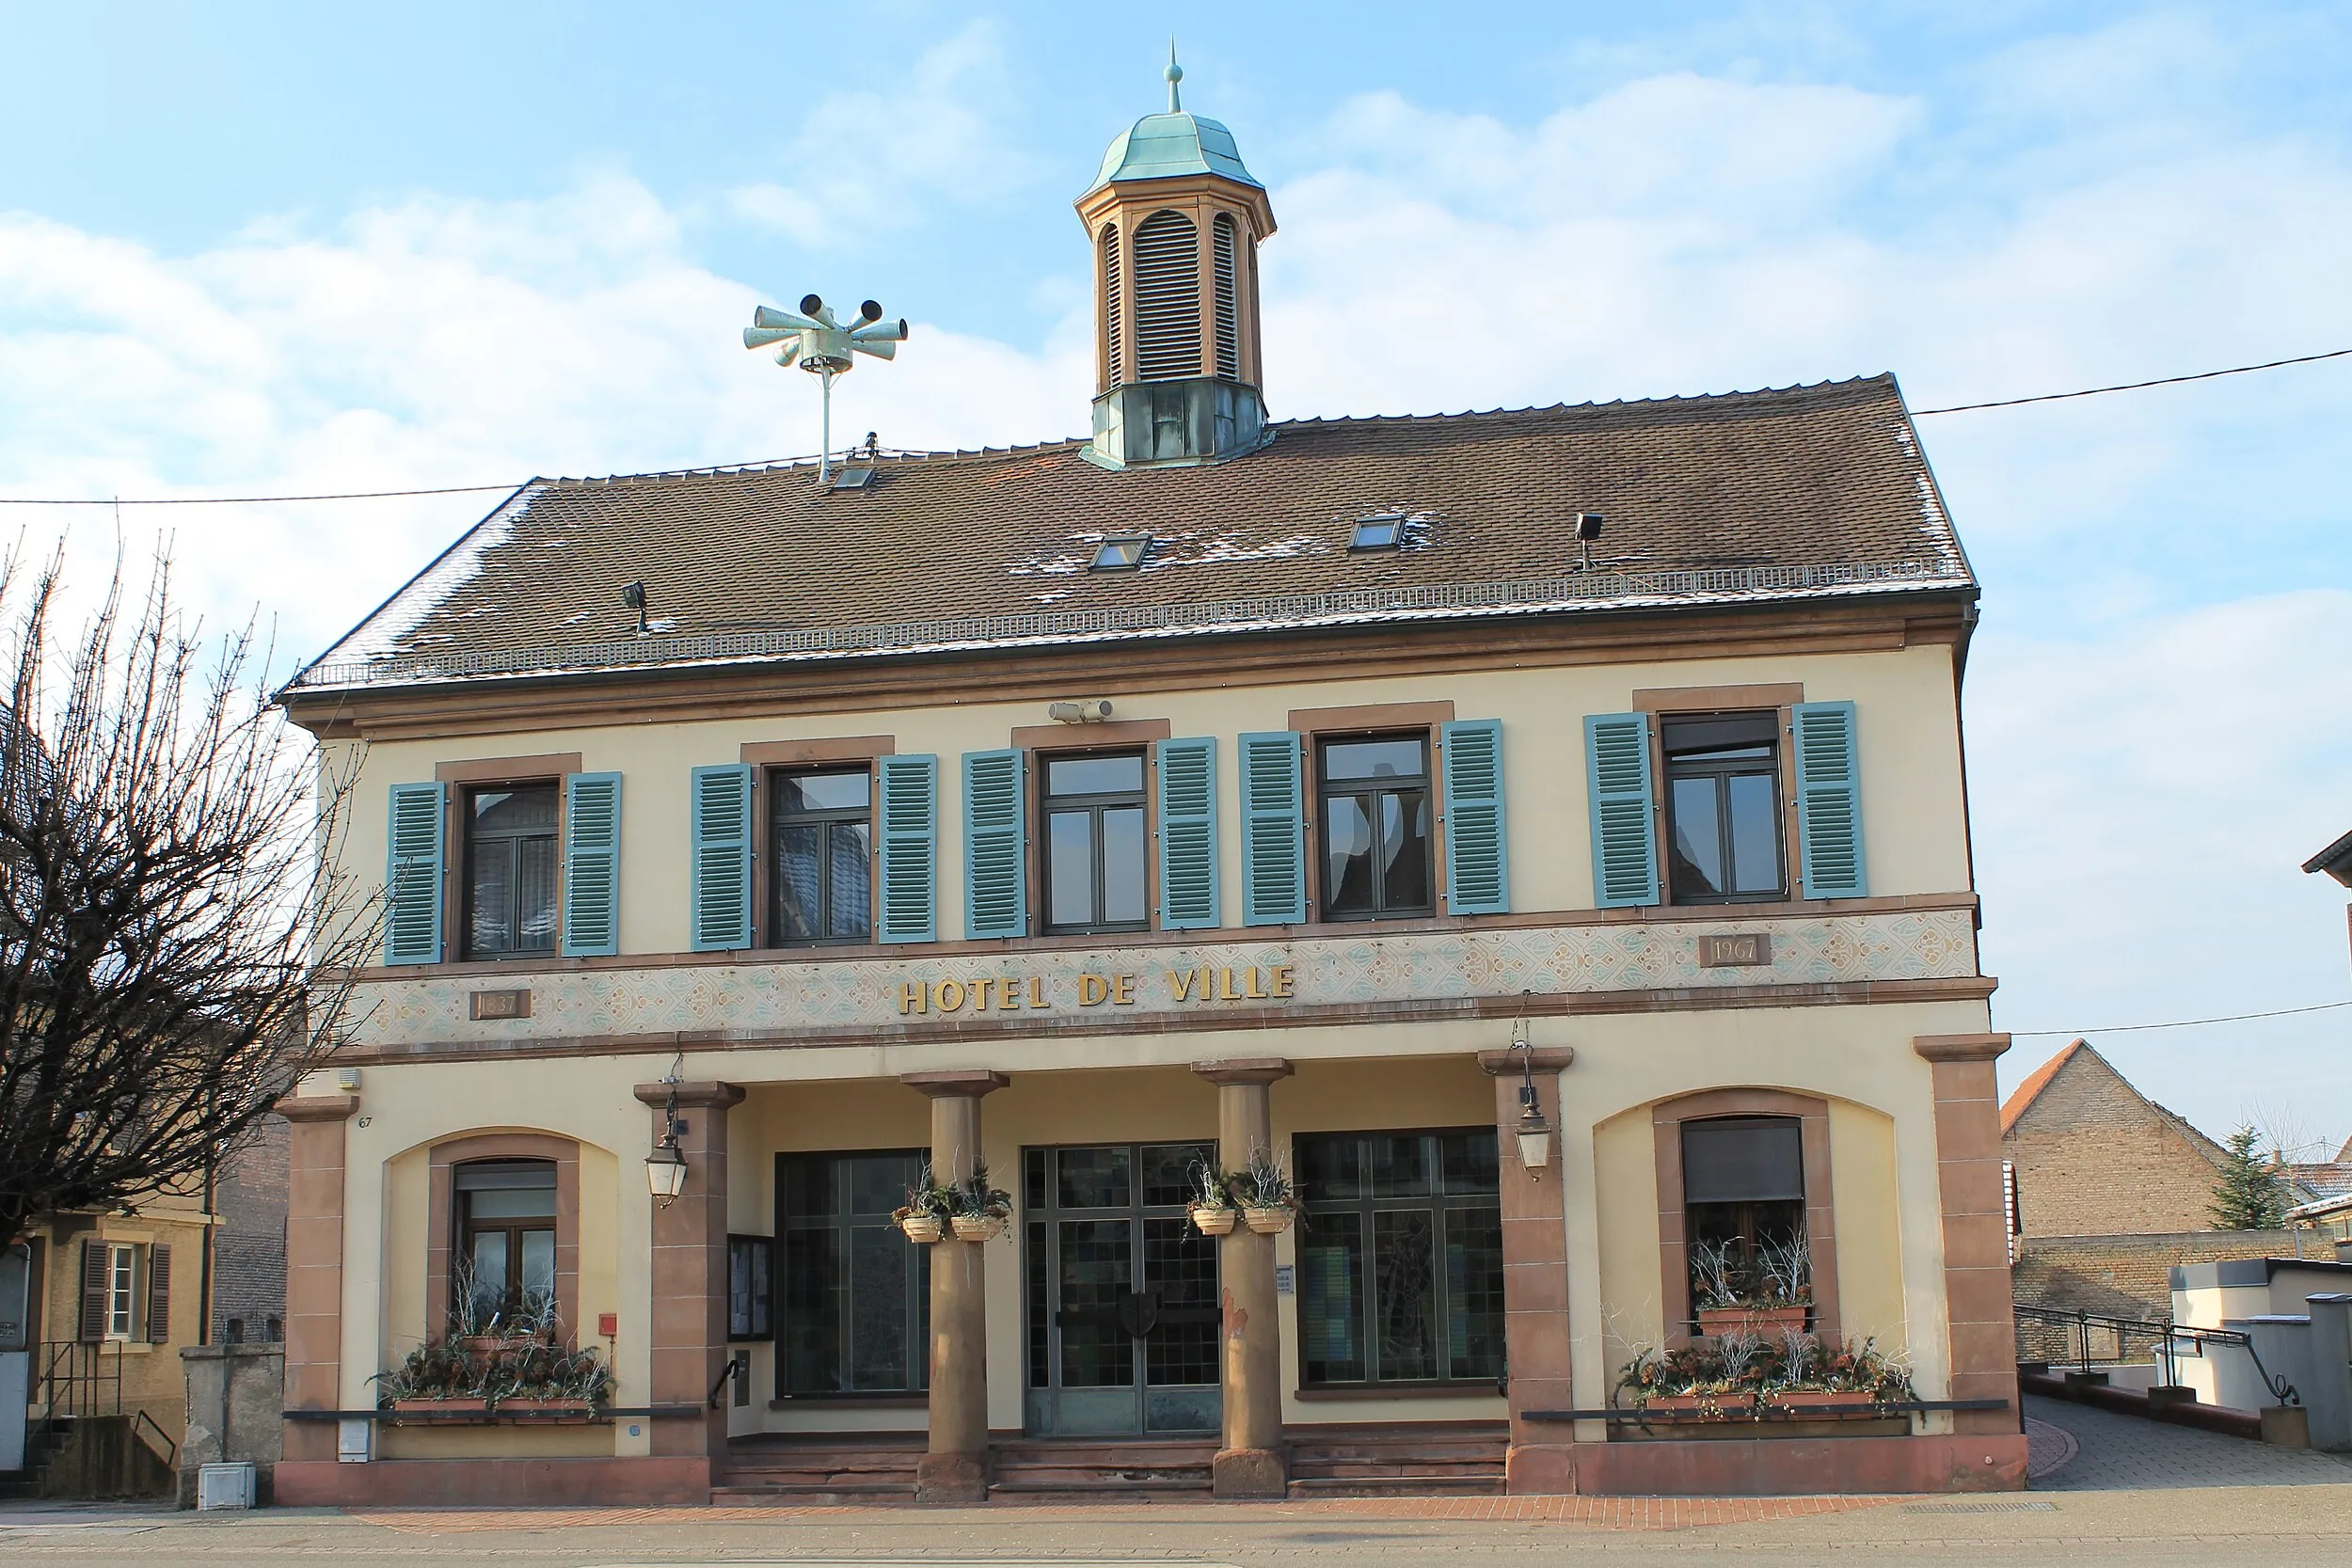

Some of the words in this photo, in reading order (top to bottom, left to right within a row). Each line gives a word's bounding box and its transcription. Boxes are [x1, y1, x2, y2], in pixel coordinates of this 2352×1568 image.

[1715, 941, 1754, 958] 1967
[898, 977, 1050, 1013] HOTEL
[1078, 972, 1134, 1006] DE
[1166, 965, 1294, 1002] VILLE
[482, 996, 516, 1013] 1837
[358, 1117, 373, 1128] 67
